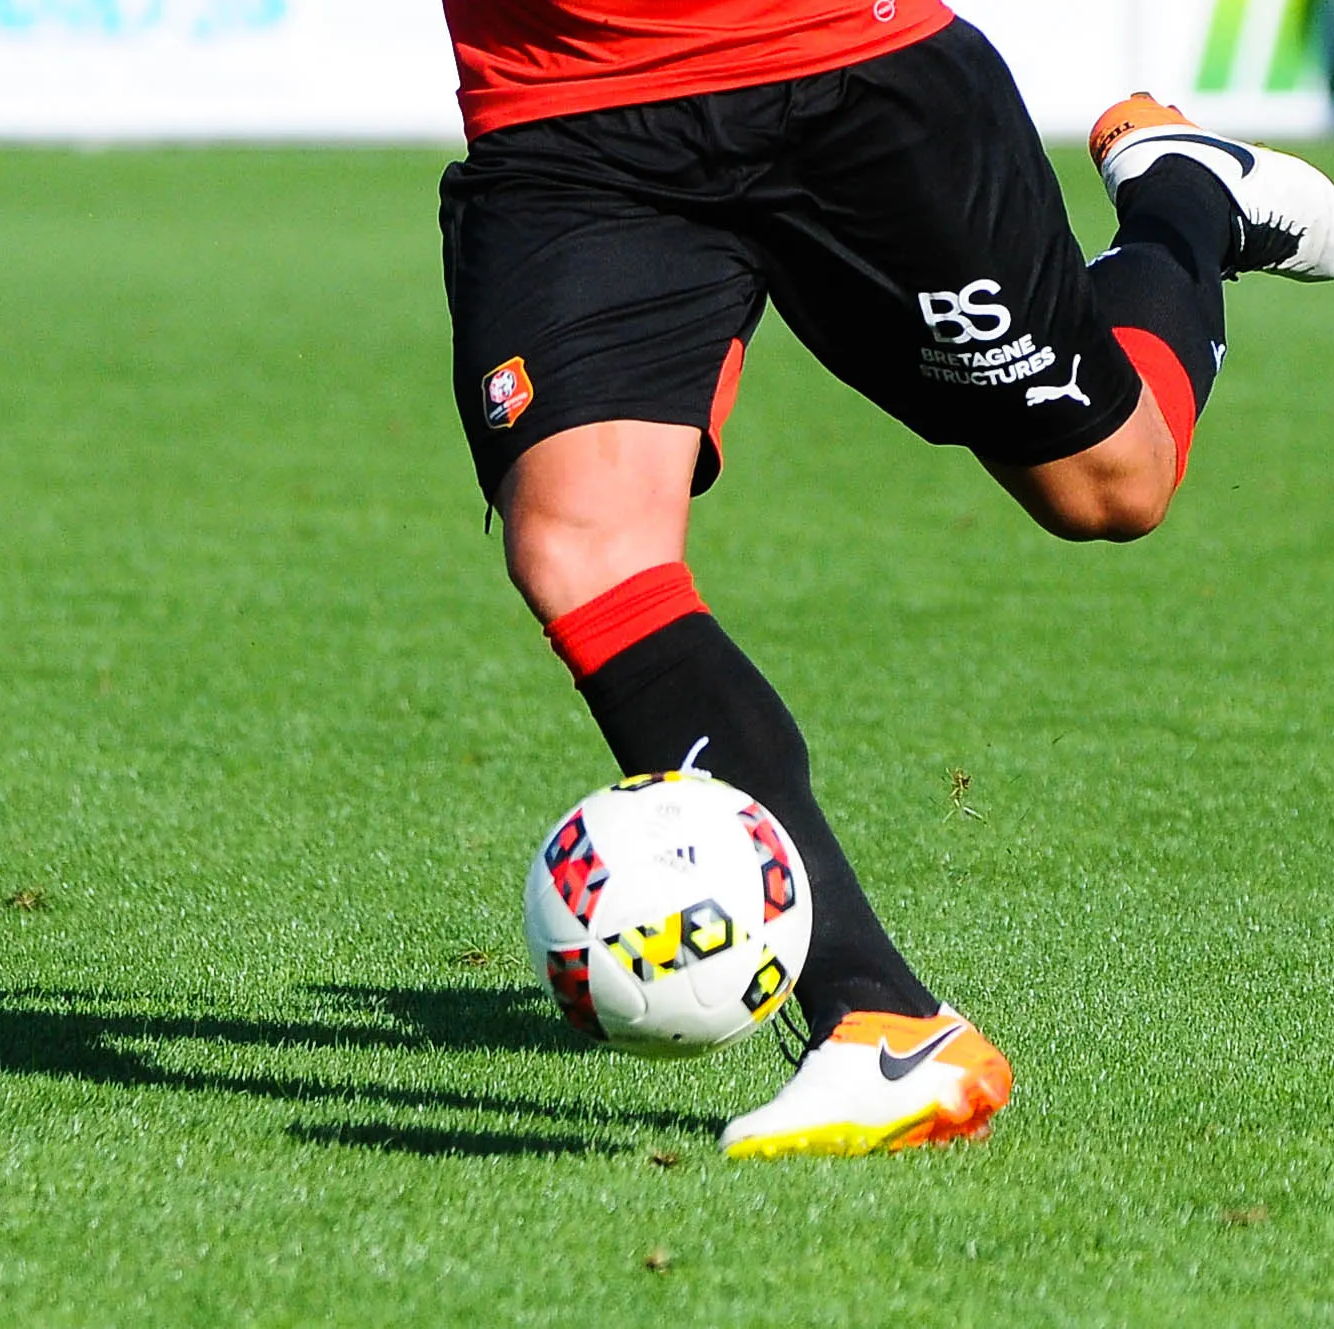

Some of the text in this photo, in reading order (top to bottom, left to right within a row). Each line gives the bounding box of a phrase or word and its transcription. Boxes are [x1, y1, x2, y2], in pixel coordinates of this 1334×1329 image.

[918, 278, 1011, 344] BS
[919, 345, 1056, 386] STRUCTURES
[921, 333, 1036, 368] BRETAGNE
